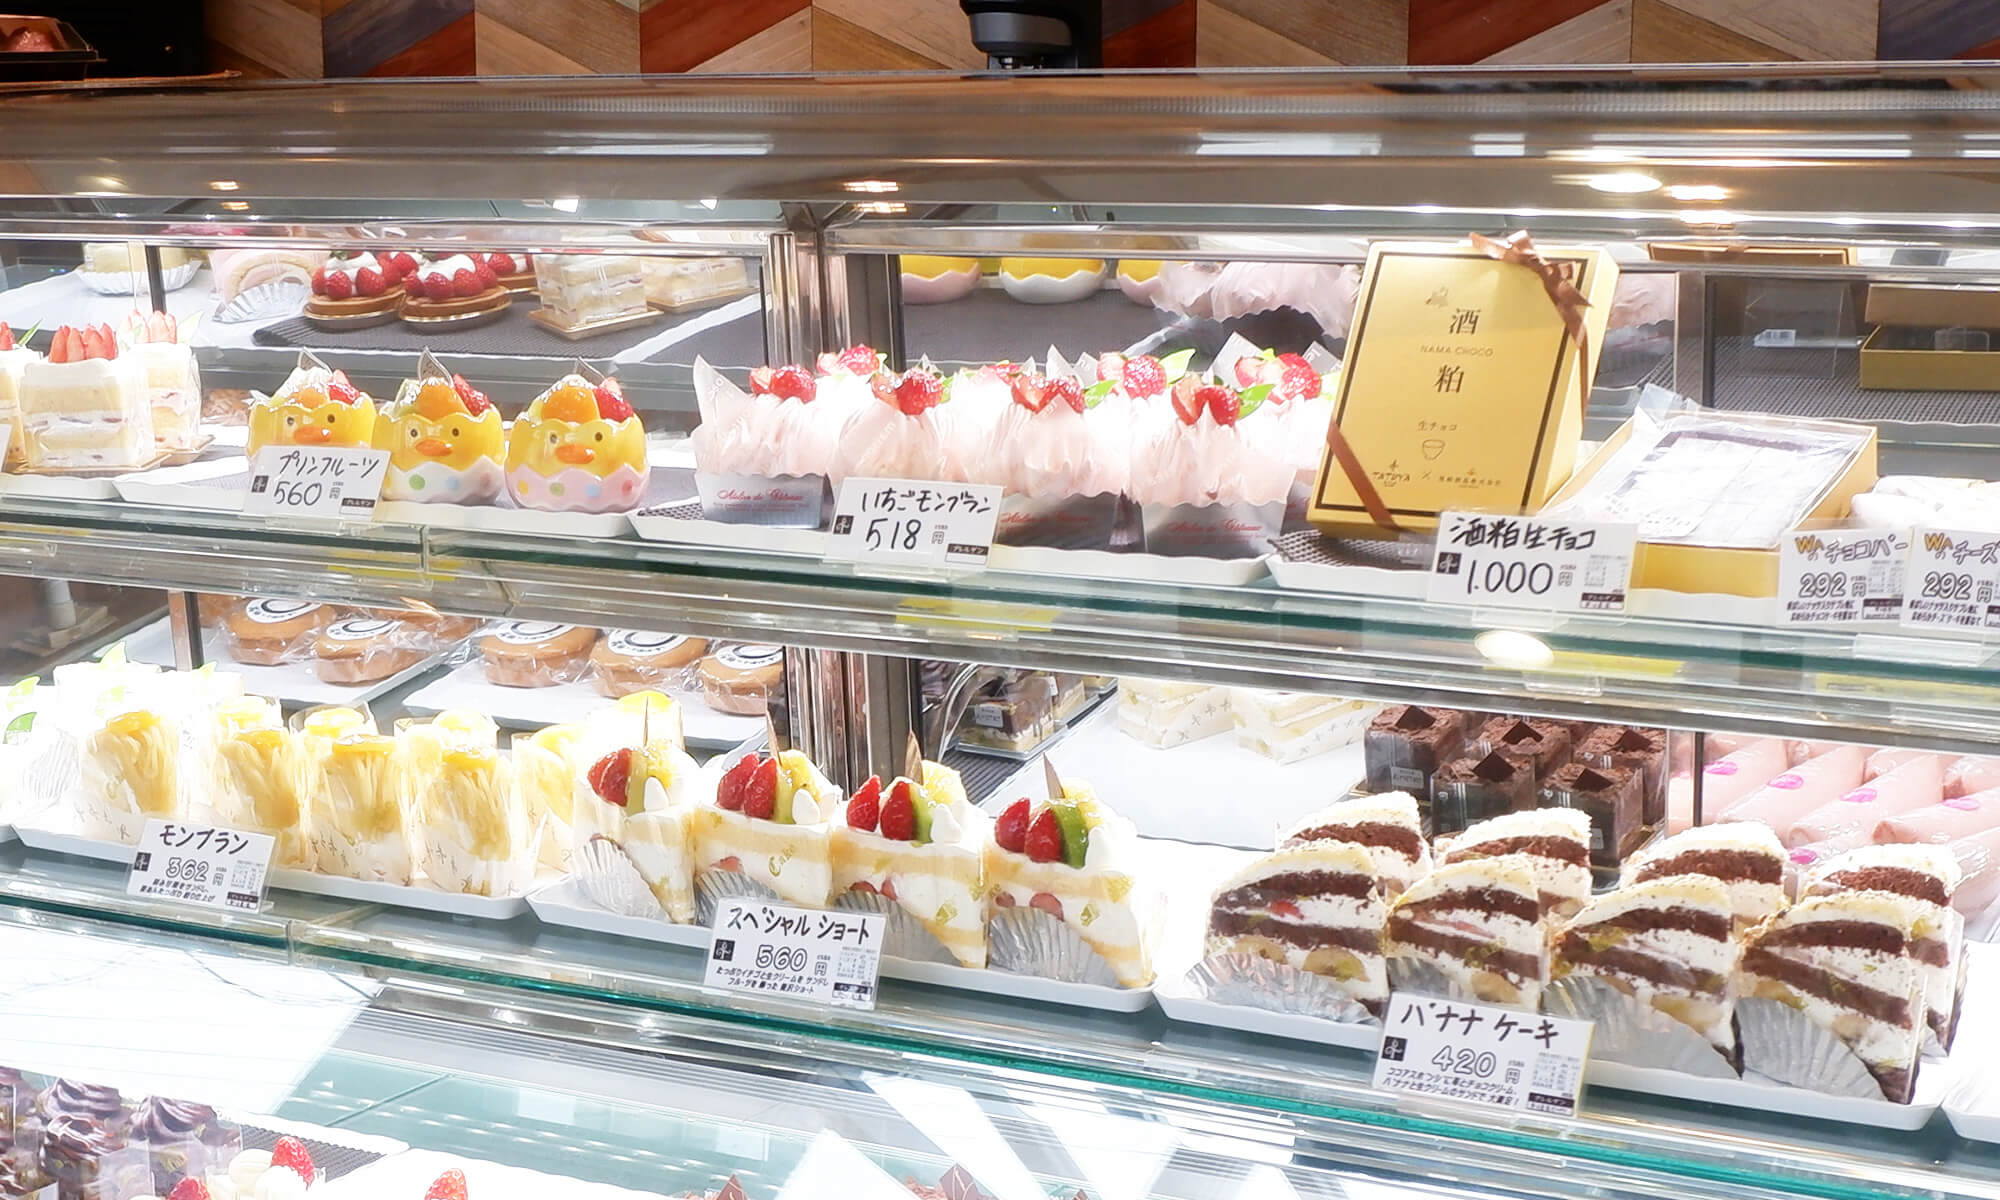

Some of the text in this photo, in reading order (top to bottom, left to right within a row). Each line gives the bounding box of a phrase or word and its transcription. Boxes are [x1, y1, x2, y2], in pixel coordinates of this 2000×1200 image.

[1449, 308, 1481, 335] 酒
[1420, 345, 1494, 357] NAMA CHOCO
[1433, 365, 1465, 394] 粕
[1417, 420, 1458, 432] 生チョコ
[280, 450, 379, 479] プリンフルーツ
[274, 481, 341, 506] 560 円
[861, 487, 991, 514] いちごモンブラン
[865, 518, 944, 552] 518 円
[1449, 517, 1596, 551] 酒粕生チョコ
[1799, 571, 1847, 598] 292
[1852, 582, 1866, 597] 円
[1923, 571, 1972, 600] 292
[1976, 587, 1992, 603] 円
[166, 857, 209, 882] 362
[756, 944, 807, 972] 560
[815, 961, 827, 976] 円
[1432, 1045, 1496, 1078] 420
[1505, 1067, 1520, 1084] 円
